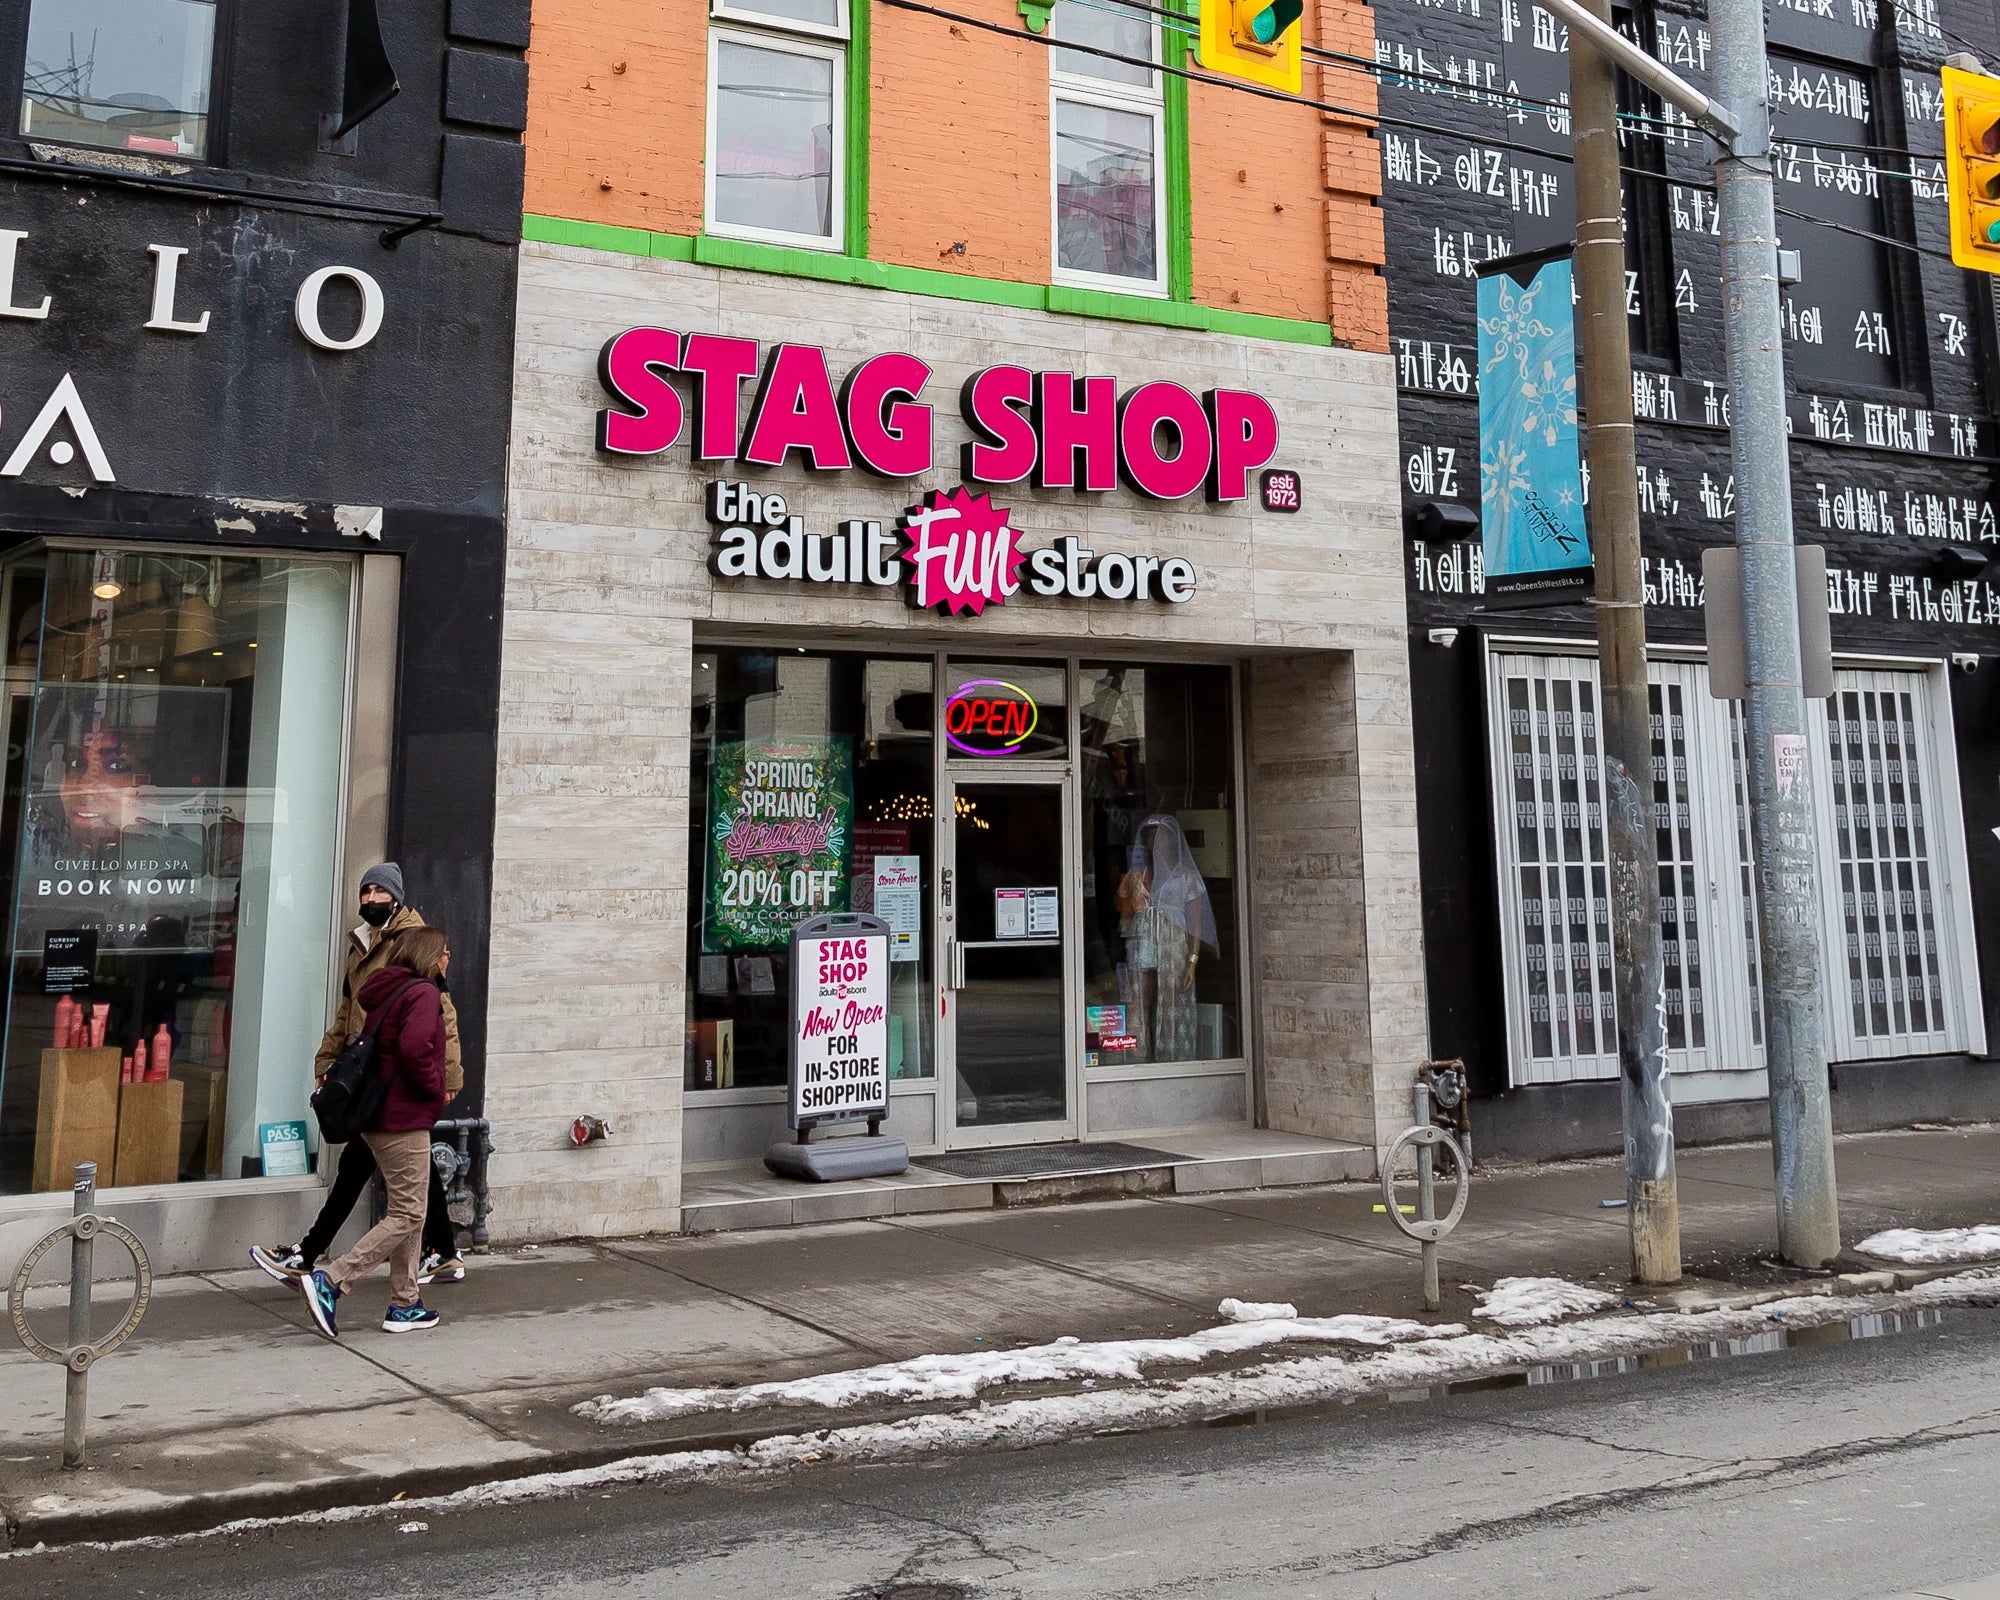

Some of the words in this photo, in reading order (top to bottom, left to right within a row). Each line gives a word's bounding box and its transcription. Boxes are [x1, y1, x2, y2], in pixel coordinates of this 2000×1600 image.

[600, 325, 934, 479] STAG
[965, 363, 1280, 501] SHOP
[1269, 474, 1294, 490] est
[713, 480, 788, 526] the
[1266, 488, 1297, 506] 1972
[1524, 490, 1582, 557] QUEEN
[1528, 512, 1552, 543] WEST
[714, 515, 901, 587] adult
[907, 507, 1020, 607] Fun
[1029, 536, 1197, 604] store
[1496, 578, 1585, 592] www.QueenStWestBIA.ca
[945, 699, 1028, 736] OPEN
[744, 762, 819, 791] SPRING,
[741, 790, 822, 821] SPRANG,
[54, 860, 120, 871] CIVELLO
[126, 860, 159, 871] MED
[164, 860, 189, 870] SPA
[37, 879, 112, 896] BOOK
[127, 879, 195, 895] NOW!
[721, 870, 783, 907] 20%
[790, 870, 839, 906] OFF
[818, 939, 868, 962] STAG
[818, 962, 868, 984] SHOP
[802, 1006, 840, 1040] Now
[843, 1000, 884, 1038] Open
[828, 1035, 858, 1056] FOR
[805, 1057, 880, 1083] IN-STORE
[802, 1080, 882, 1108] SHOPPING
[267, 1127, 300, 1142] PASS
